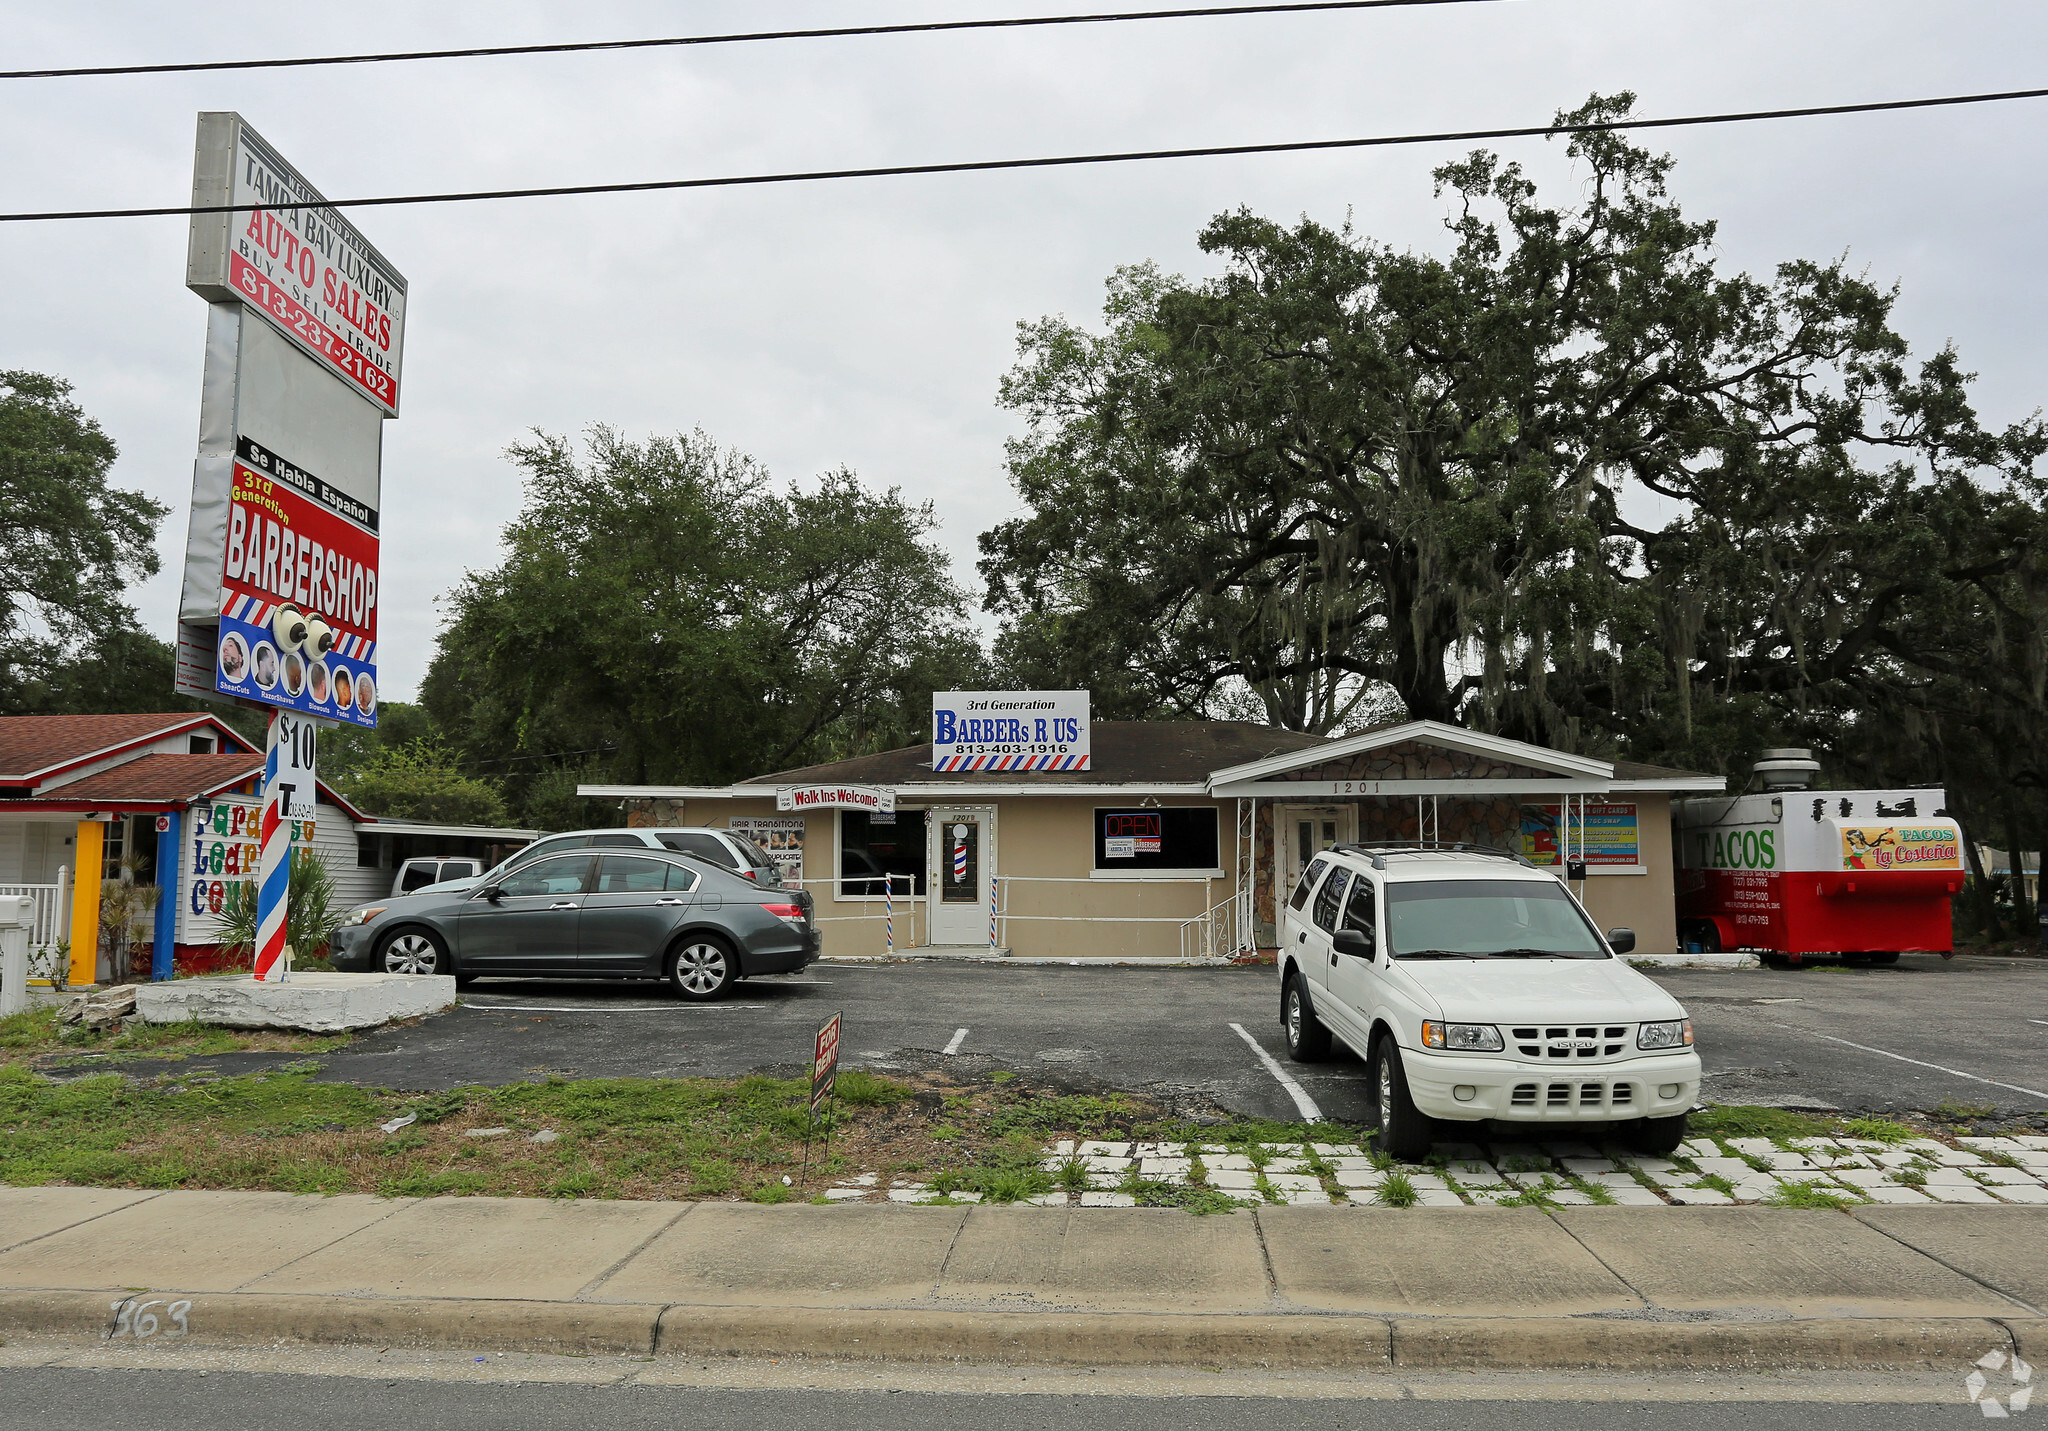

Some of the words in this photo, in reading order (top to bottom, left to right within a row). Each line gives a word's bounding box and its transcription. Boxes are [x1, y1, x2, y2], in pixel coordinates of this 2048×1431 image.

[244, 152, 299, 231] TAMPA
[305, 212, 335, 260] BAY
[338, 243, 392, 312] LUXURY
[344, 232, 369, 261] PLAZA
[247, 201, 316, 289] AUTO
[323, 267, 391, 352] SALES
[240, 239, 274, 278] BUY
[292, 285, 330, 328] SELL
[346, 329, 393, 377] TRADE
[241, 267, 389, 399] 813-237-2162
[242, 471, 273, 496] 3rd
[250, 445, 269, 468] Se
[275, 459, 316, 494] Habla
[321, 485, 369, 523] Español
[231, 486, 290, 526] Generation
[226, 503, 376, 631] BARBERSHOP
[220, 681, 250, 696] ShearCuts
[261, 690, 295, 705] RazorShaves
[308, 702, 331, 714] Blowouts
[336, 709, 350, 719] Fades
[967, 700, 988, 711] 3rd
[990, 700, 1056, 711] Generation
[357, 715, 374, 725] Designs
[1034, 718, 1048, 743] R
[280, 712, 315, 771] $10
[955, 744, 1068, 754] 813-403-1916
[794, 790, 820, 806] Walk
[821, 789, 836, 803] Ins
[837, 789, 878, 807] Welcome
[1333, 782, 1379, 794] 1201
[1107, 816, 1159, 836] OPEN
[1897, 829, 1955, 841] TACOS
[1697, 829, 1776, 869] TACOS
[1872, 847, 1891, 869] La
[1895, 843, 1956, 863] Costeña
[820, 1023, 837, 1055] FOR
[815, 1040, 838, 1079] RENT
[107, 1299, 192, 1338] 363
